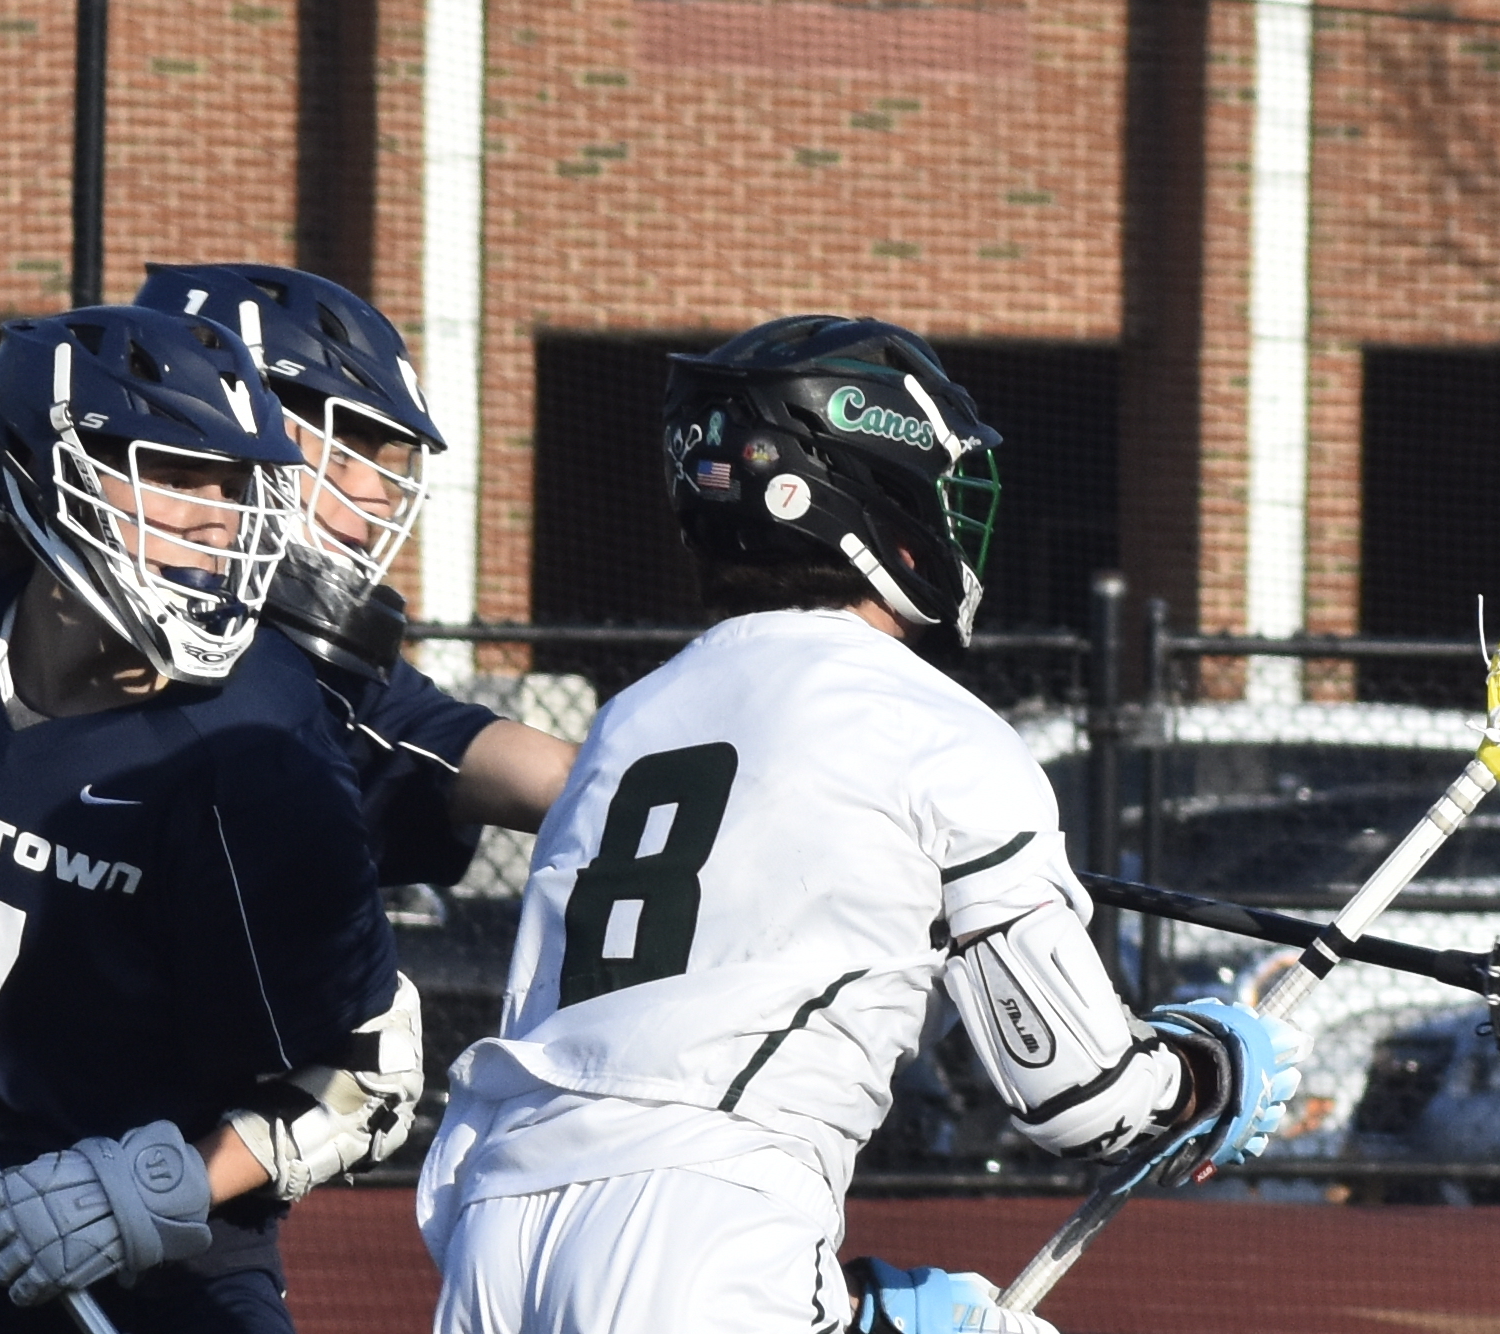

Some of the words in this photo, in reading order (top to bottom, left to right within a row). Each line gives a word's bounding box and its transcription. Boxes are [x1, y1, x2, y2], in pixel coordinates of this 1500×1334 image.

[827, 385, 934, 451] Canes
[780, 483, 798, 509] 7
[558, 740, 739, 1011] 8
